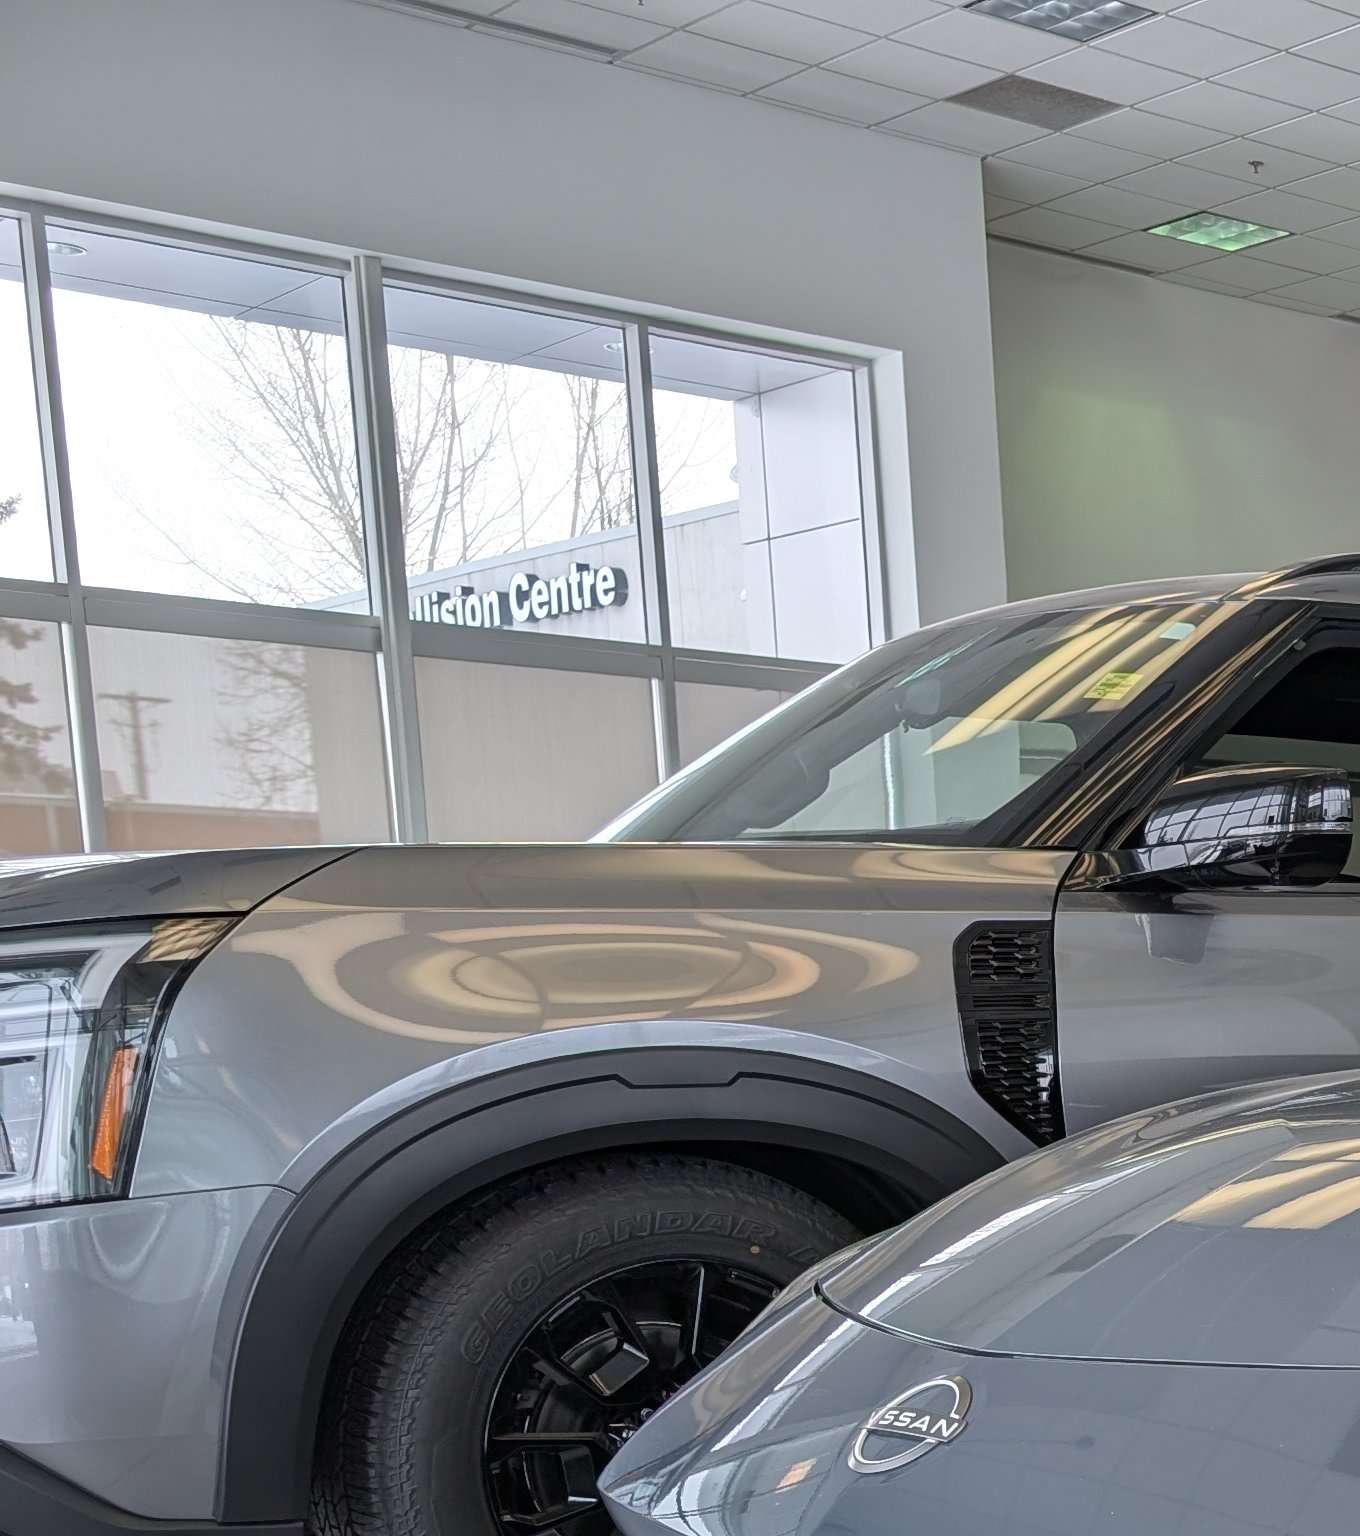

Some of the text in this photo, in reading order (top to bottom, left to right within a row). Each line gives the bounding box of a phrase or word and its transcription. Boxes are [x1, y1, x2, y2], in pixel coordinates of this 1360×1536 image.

[409, 562, 616, 628] llision Centre
[461, 1209, 777, 1364] GEOLANDAR
[872, 1410, 959, 1437] SSAN
